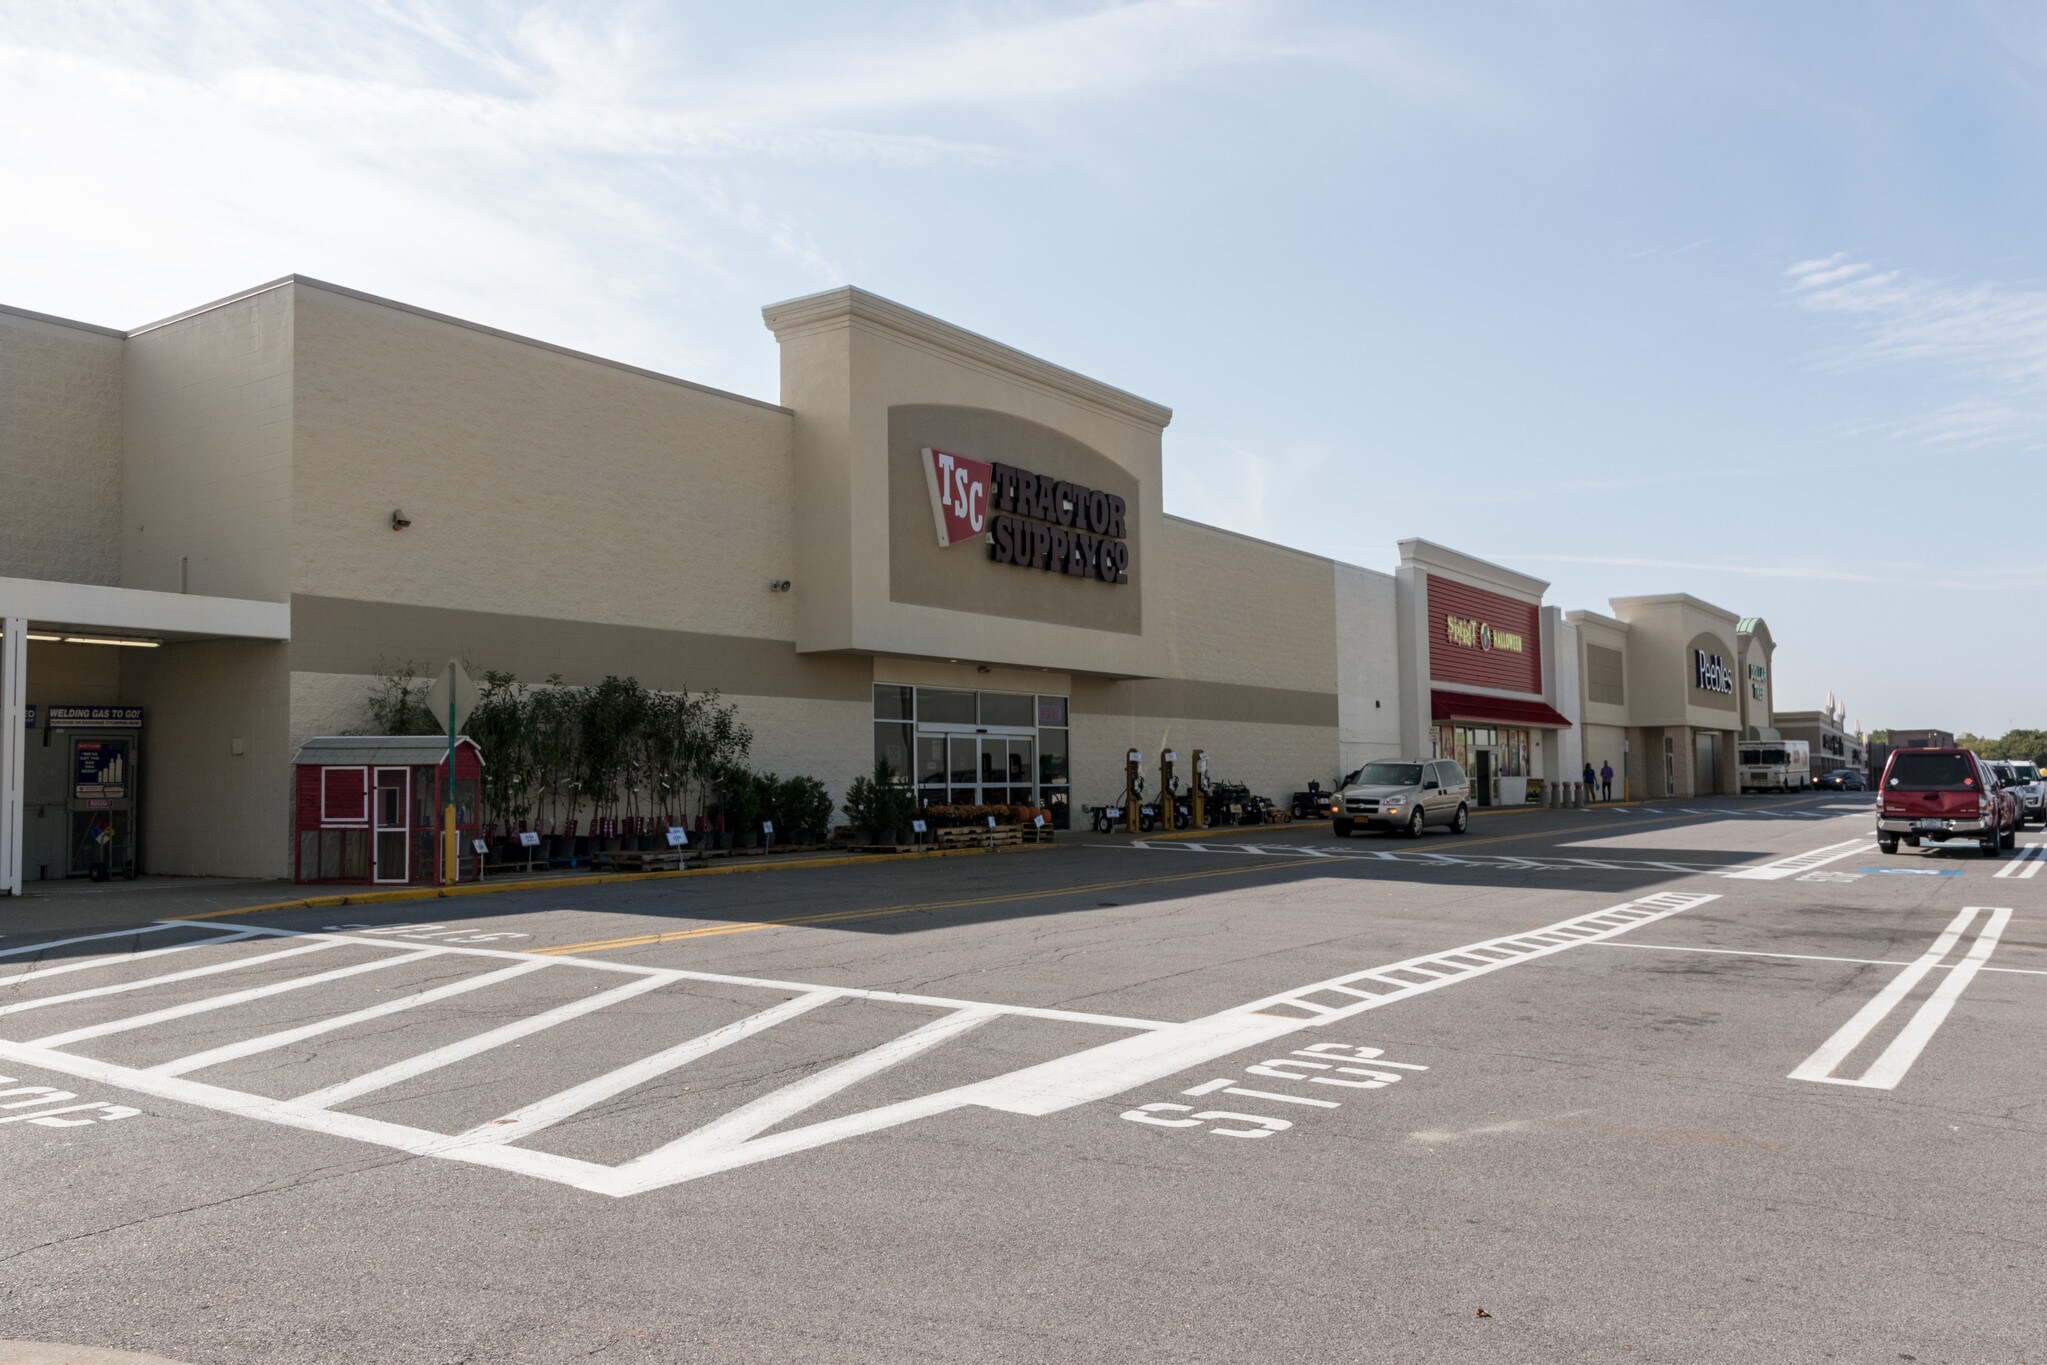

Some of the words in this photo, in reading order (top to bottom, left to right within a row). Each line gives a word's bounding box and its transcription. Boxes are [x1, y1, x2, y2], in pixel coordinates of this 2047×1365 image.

[938, 452, 984, 533] TSC
[992, 462, 1127, 539] TRACTOR
[989, 515, 1098, 579] SUPPLY
[1698, 649, 1733, 694] Peebles
[50, 709, 90, 718] WELDING
[92, 709, 110, 718] GAS
[112, 710, 123, 718] TO
[125, 710, 140, 718] GO!
[1119, 1042, 1430, 1138] STOP
